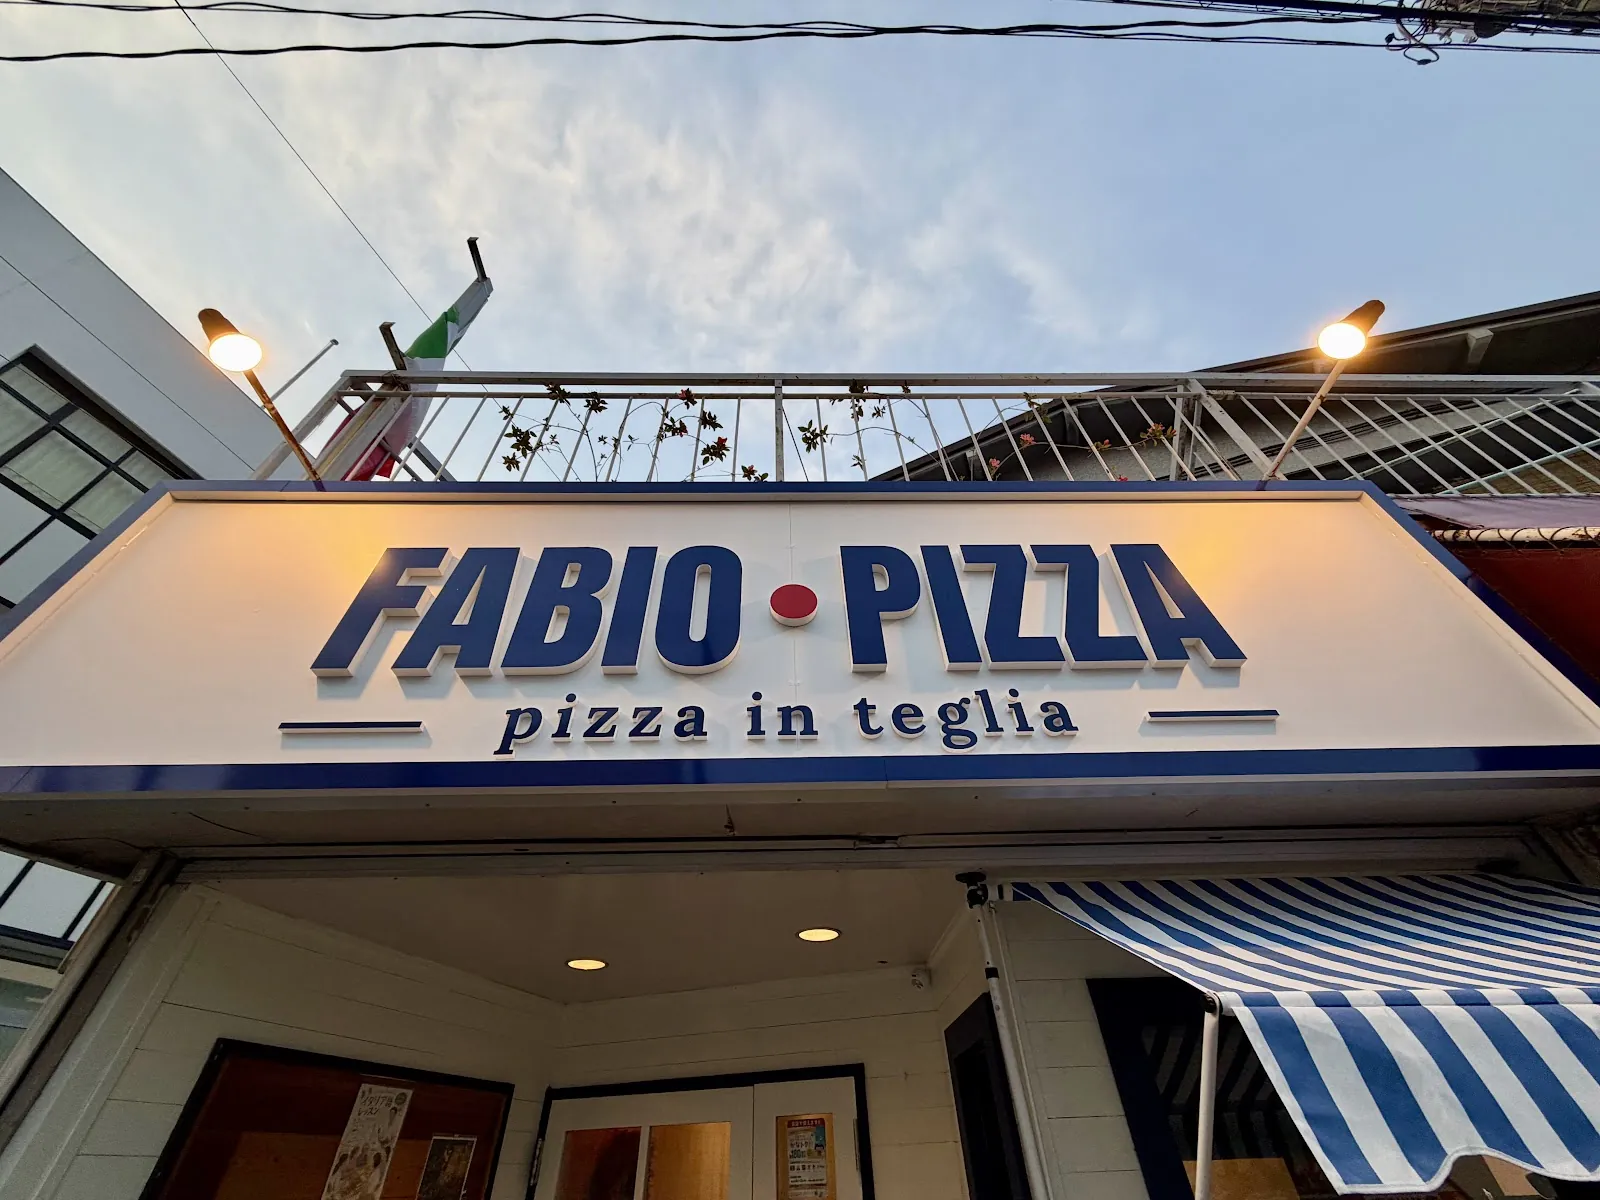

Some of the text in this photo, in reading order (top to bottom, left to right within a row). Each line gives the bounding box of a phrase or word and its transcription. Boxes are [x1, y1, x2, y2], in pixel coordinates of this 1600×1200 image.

[310, 543, 1248, 676] FABIO PIZZA
[493, 688, 1079, 758] pizza in teglia
